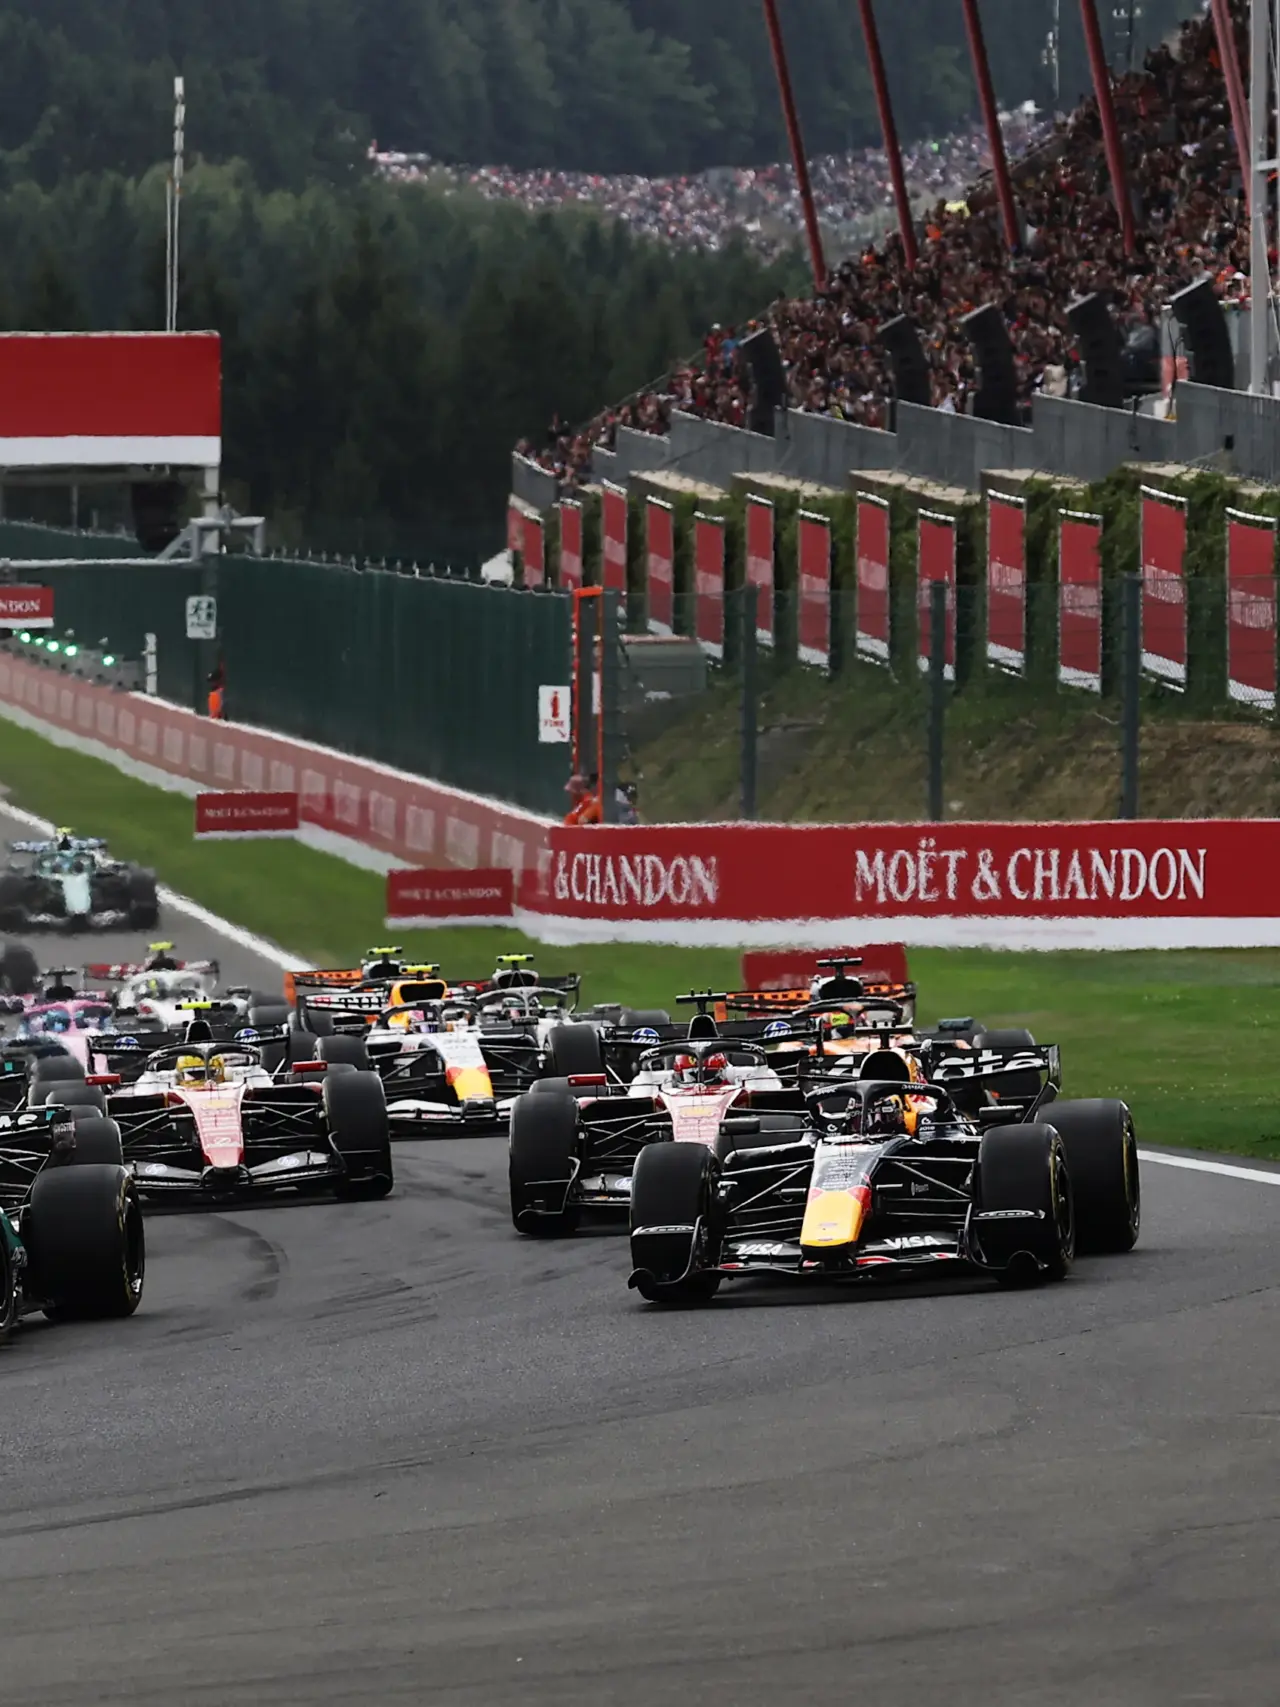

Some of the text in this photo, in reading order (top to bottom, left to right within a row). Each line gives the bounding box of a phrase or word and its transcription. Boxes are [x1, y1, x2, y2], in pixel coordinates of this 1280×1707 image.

[554, 851, 570, 899] &
[571, 853, 718, 906] CHANDON
[855, 838, 1207, 903] MOËT & CHANDON
[736, 1243, 783, 1255] VISA
[884, 1235, 942, 1249] VISA
